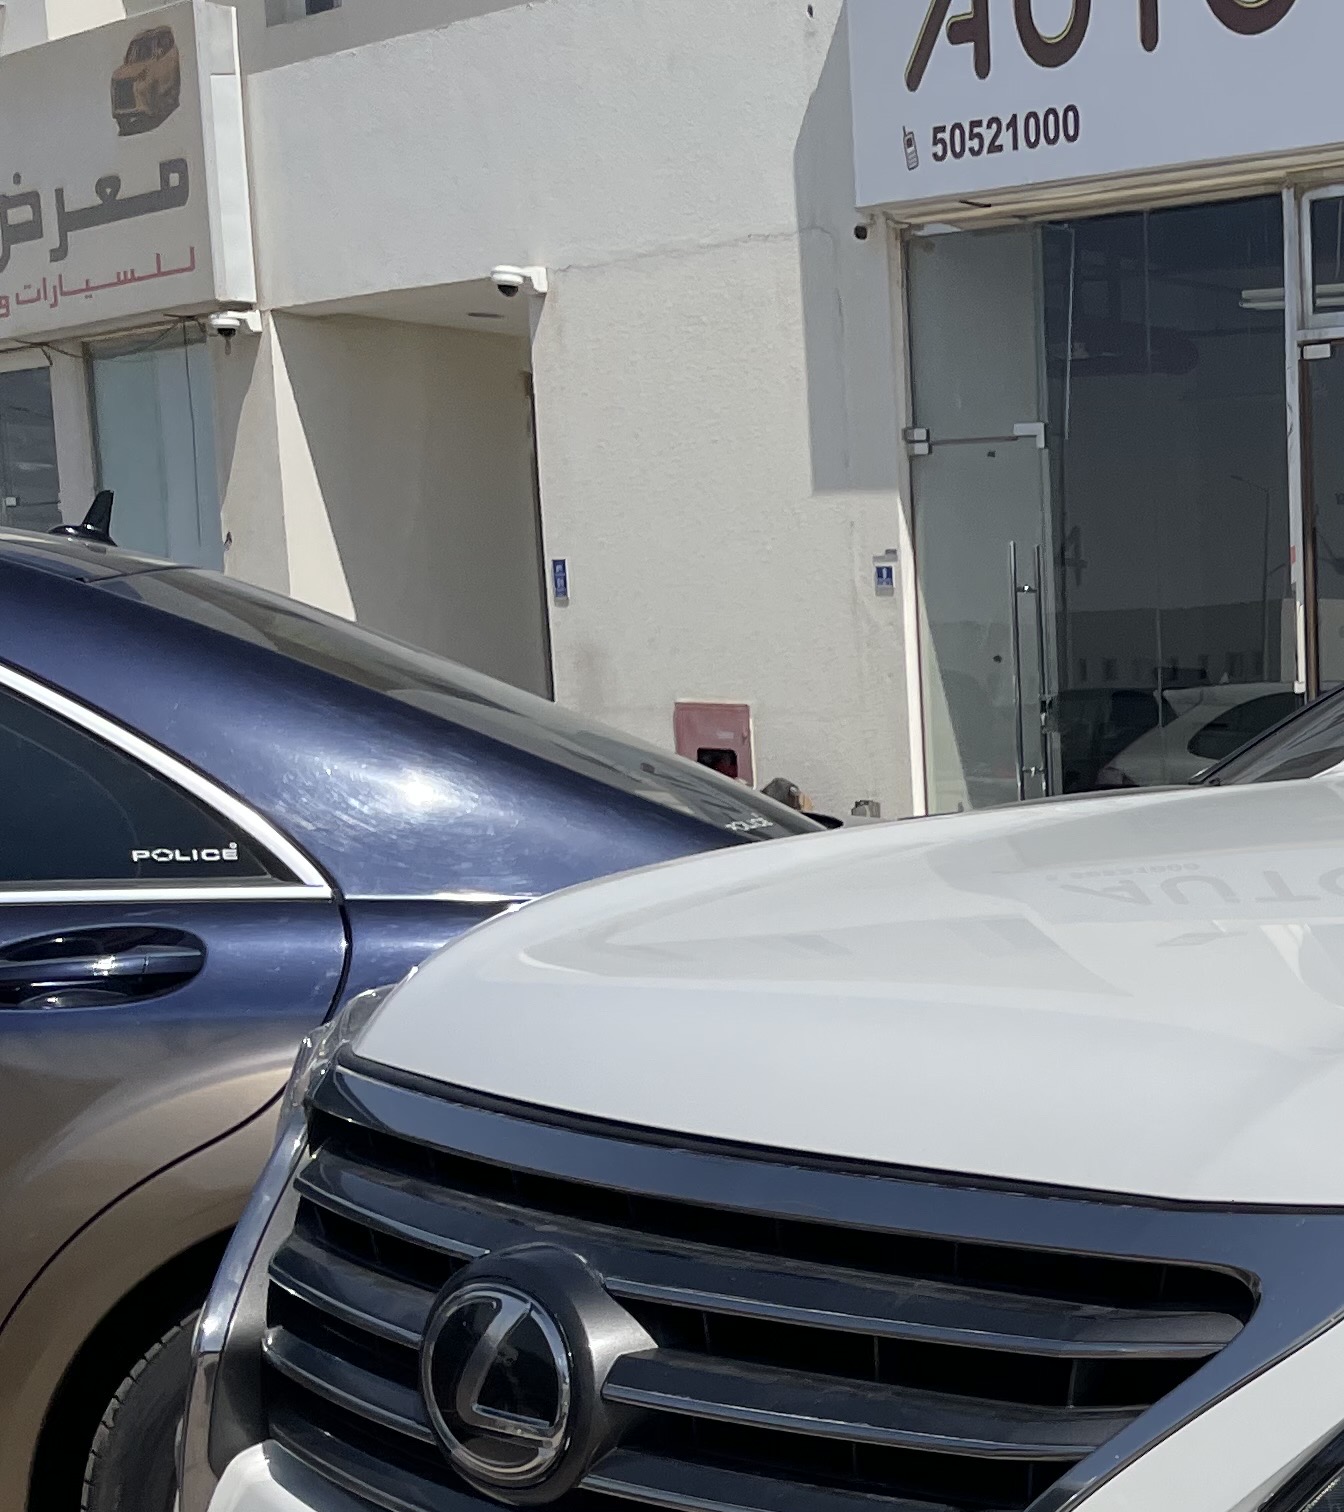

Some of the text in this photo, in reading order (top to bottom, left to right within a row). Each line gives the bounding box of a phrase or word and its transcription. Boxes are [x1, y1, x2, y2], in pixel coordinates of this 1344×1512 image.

[931, 104, 1081, 162] 50521000
[15, 246, 196, 309] للسيارات
[131, 847, 239, 862] POLICE
